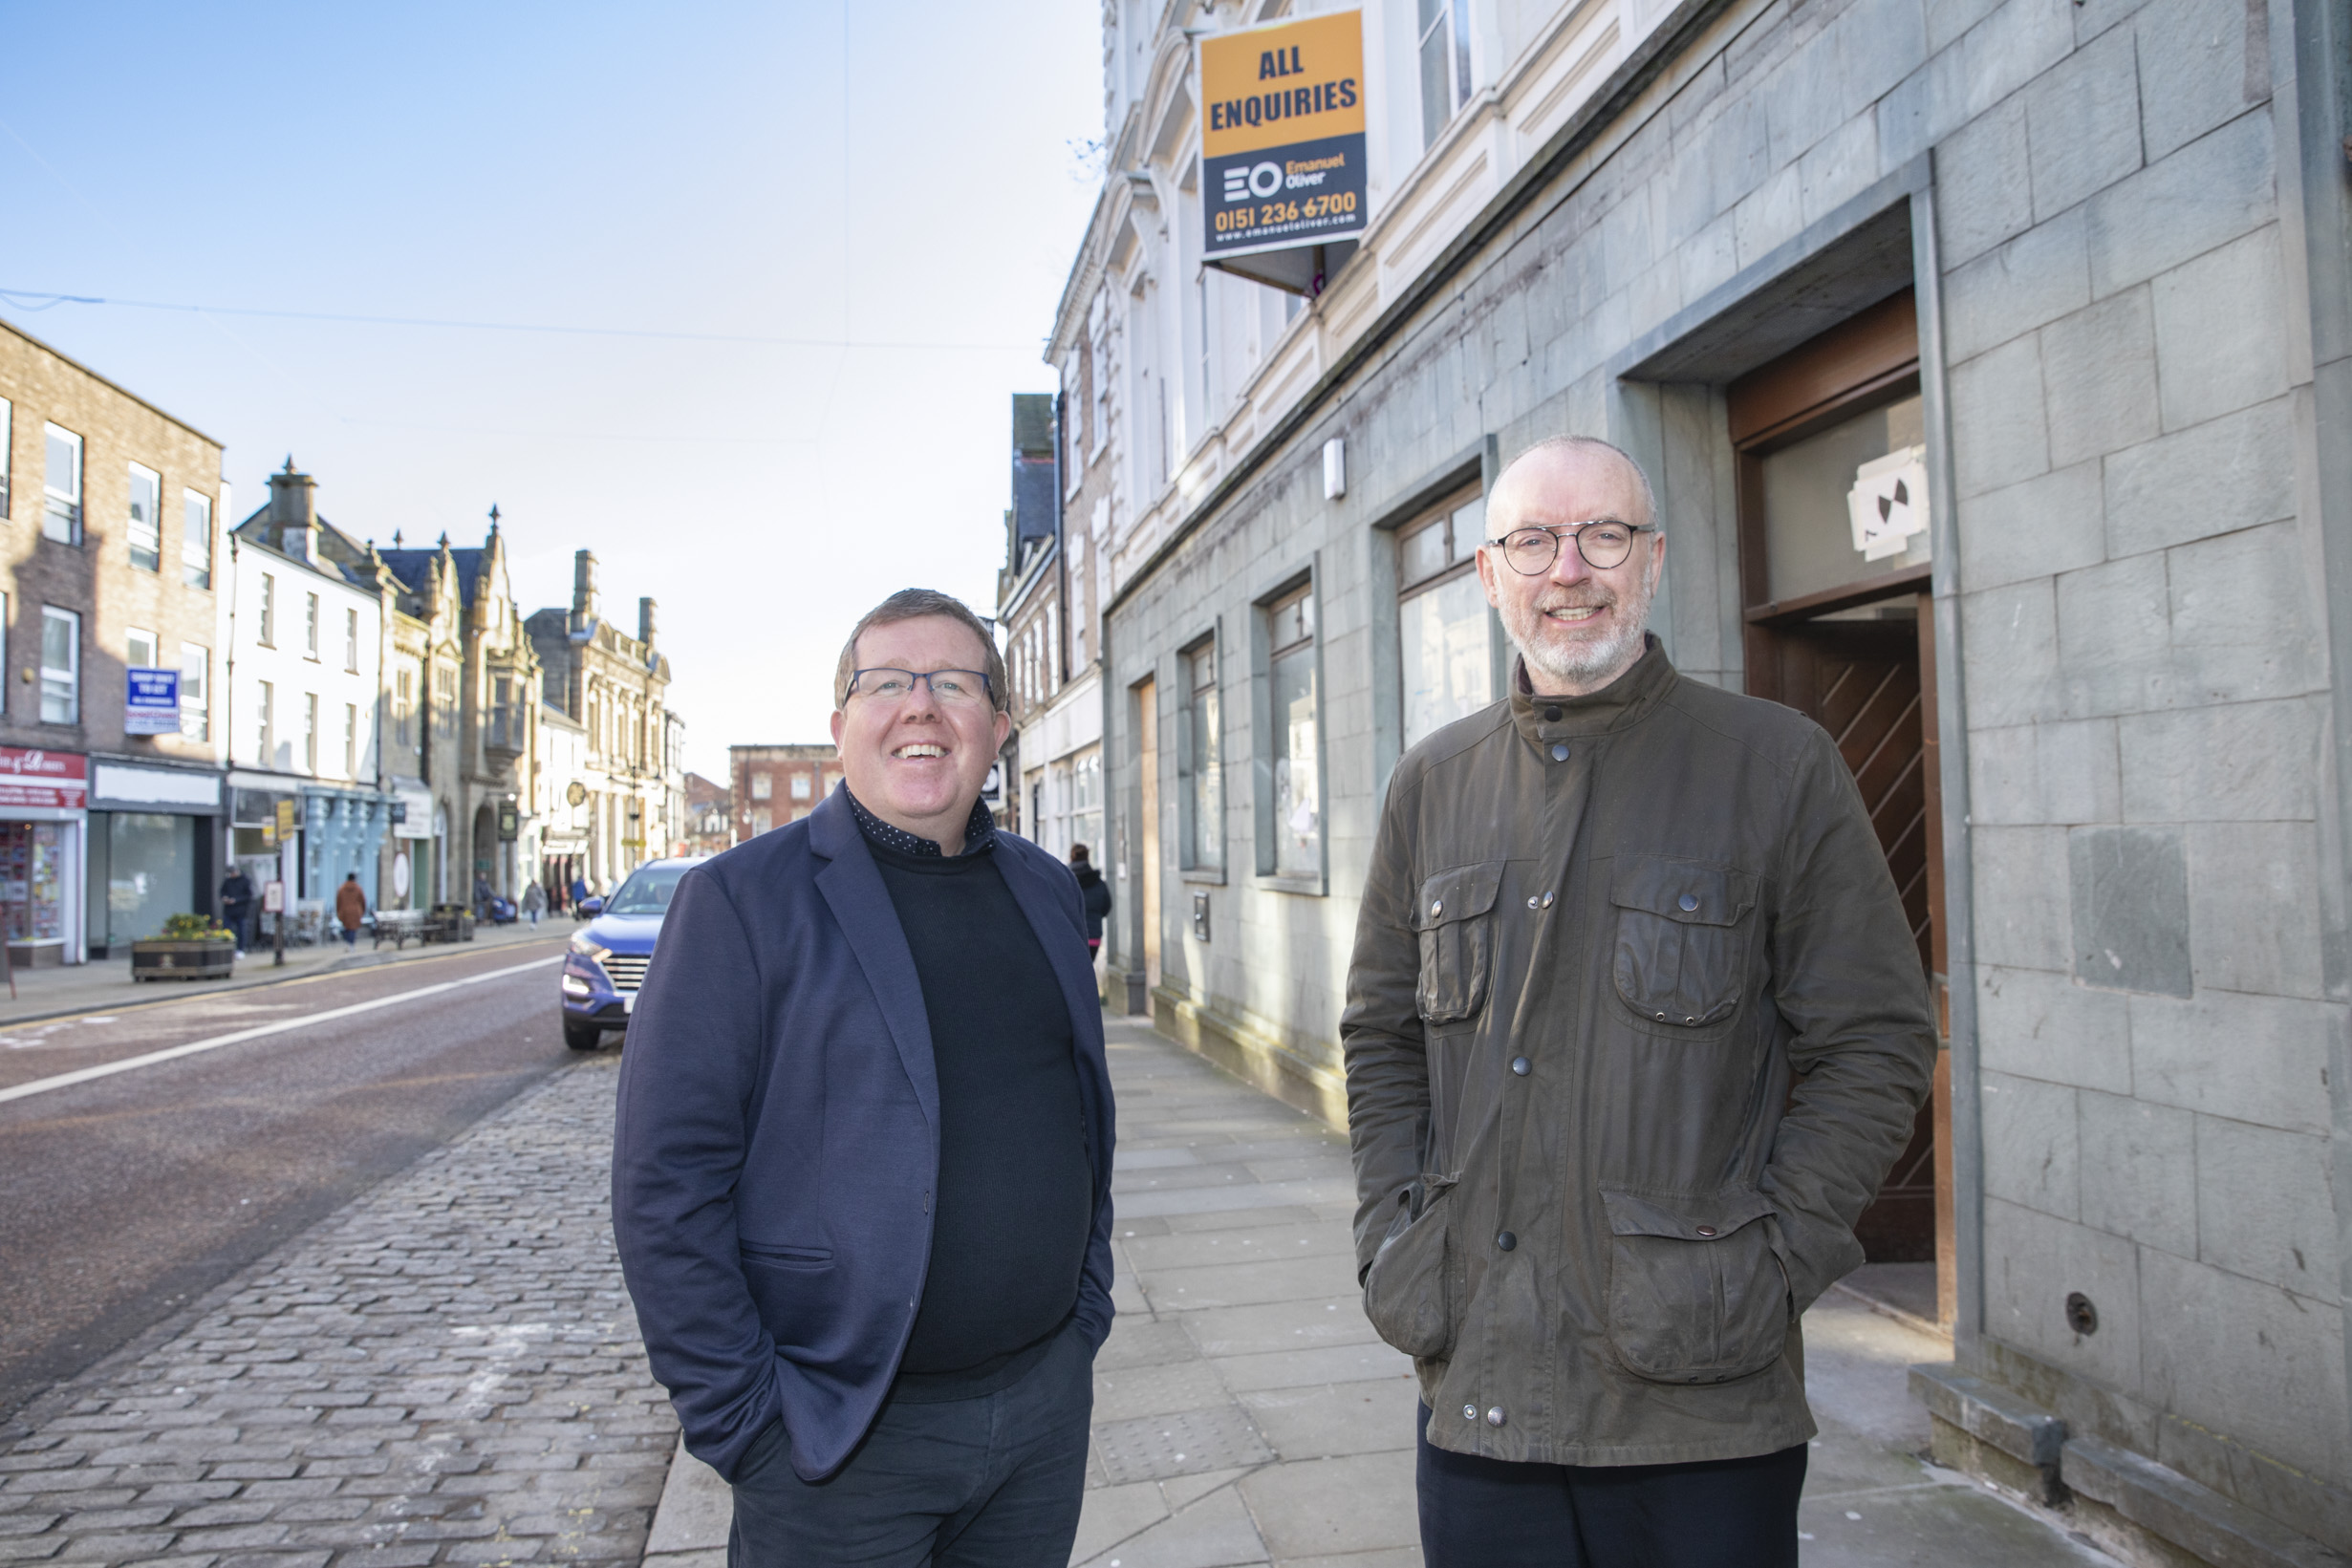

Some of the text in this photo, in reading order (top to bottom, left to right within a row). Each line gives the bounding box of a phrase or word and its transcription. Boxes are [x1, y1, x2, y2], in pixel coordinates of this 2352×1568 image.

[1259, 46, 1305, 80] ALL
[1211, 78, 1356, 132] ENQUIRIES
[1285, 152, 1346, 175] Emanuel
[1285, 171, 1327, 189] Oliver
[1215, 191, 1356, 232] 0151 236 6700
[1216, 213, 1356, 241] www.emanueloliver.com
